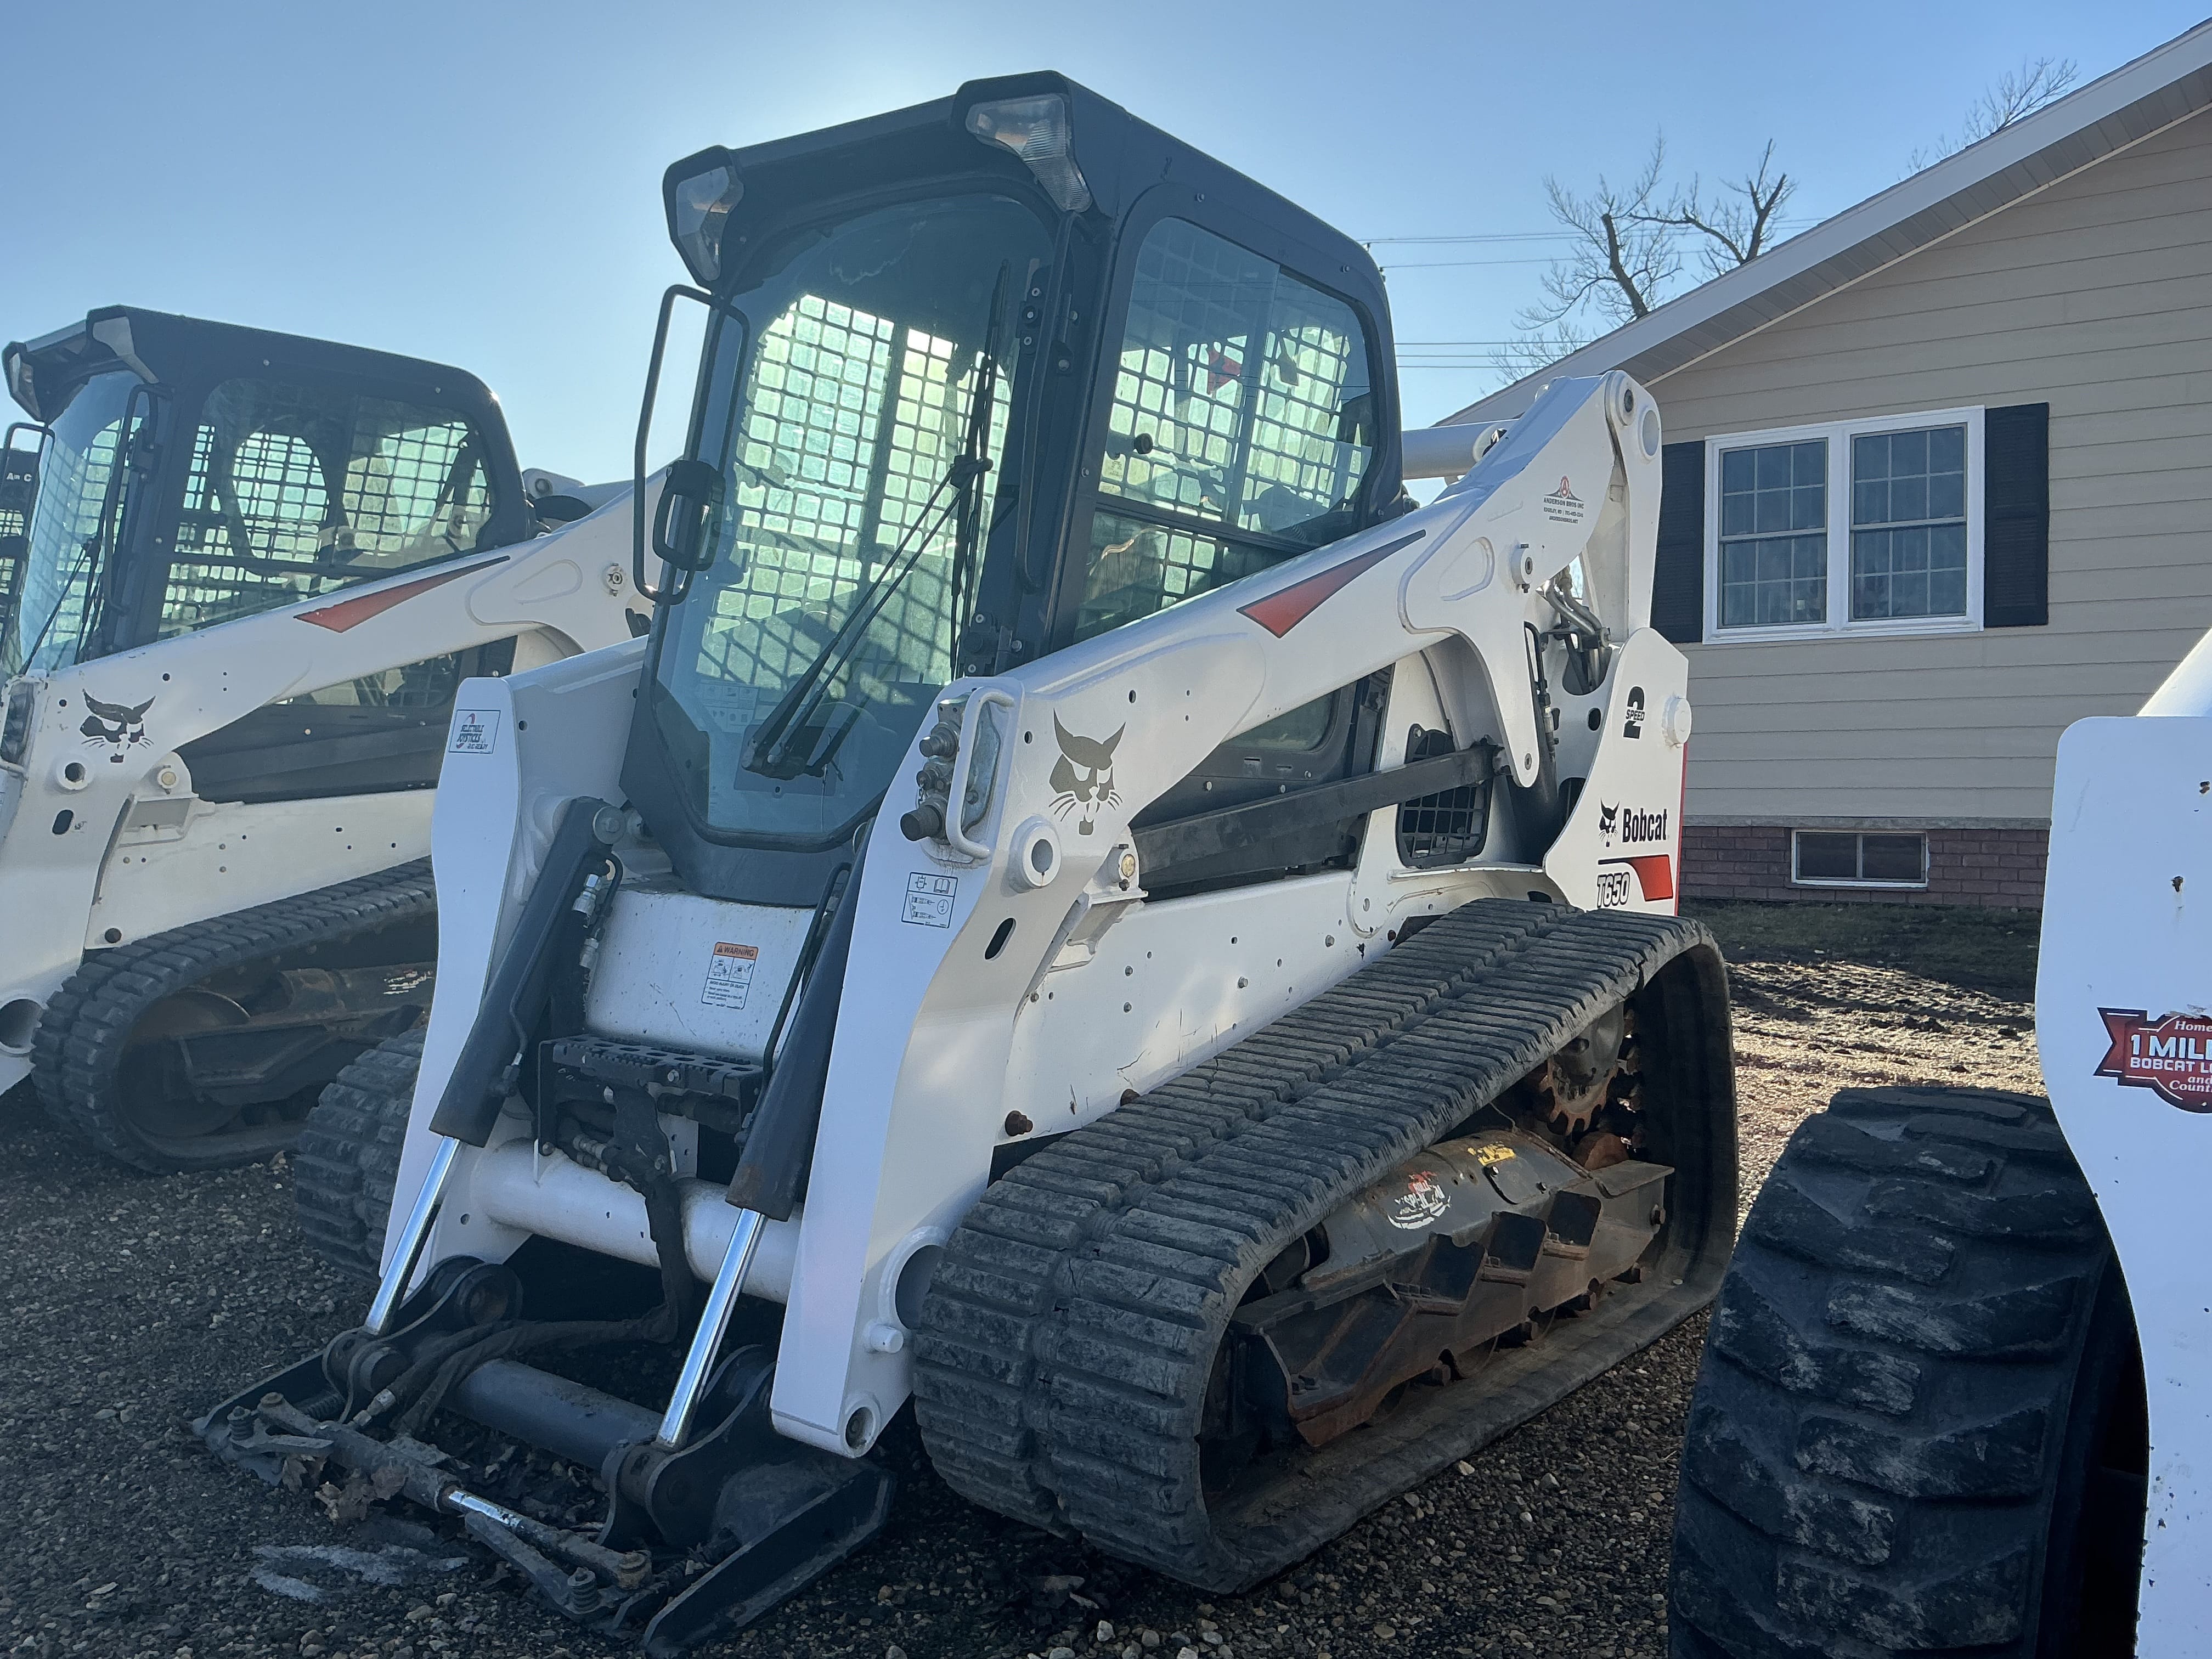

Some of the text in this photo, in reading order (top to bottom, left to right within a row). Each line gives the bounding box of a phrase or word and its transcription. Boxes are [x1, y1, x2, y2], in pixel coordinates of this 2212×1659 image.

[1544, 498, 1565, 506] ANDERSON
[1626, 709, 1645, 721] SPEED
[1622, 808, 1667, 843] Bobcat
[1597, 871, 1630, 909] T650
[724, 946, 754, 957] WARNING
[2175, 1020, 2212, 1032] Home
[2131, 1034, 2140, 1056] 1
[2130, 1057, 2212, 1074] BOBCAT L
[2188, 1075, 2212, 1085] and
[2169, 1080, 2212, 1093] Count
